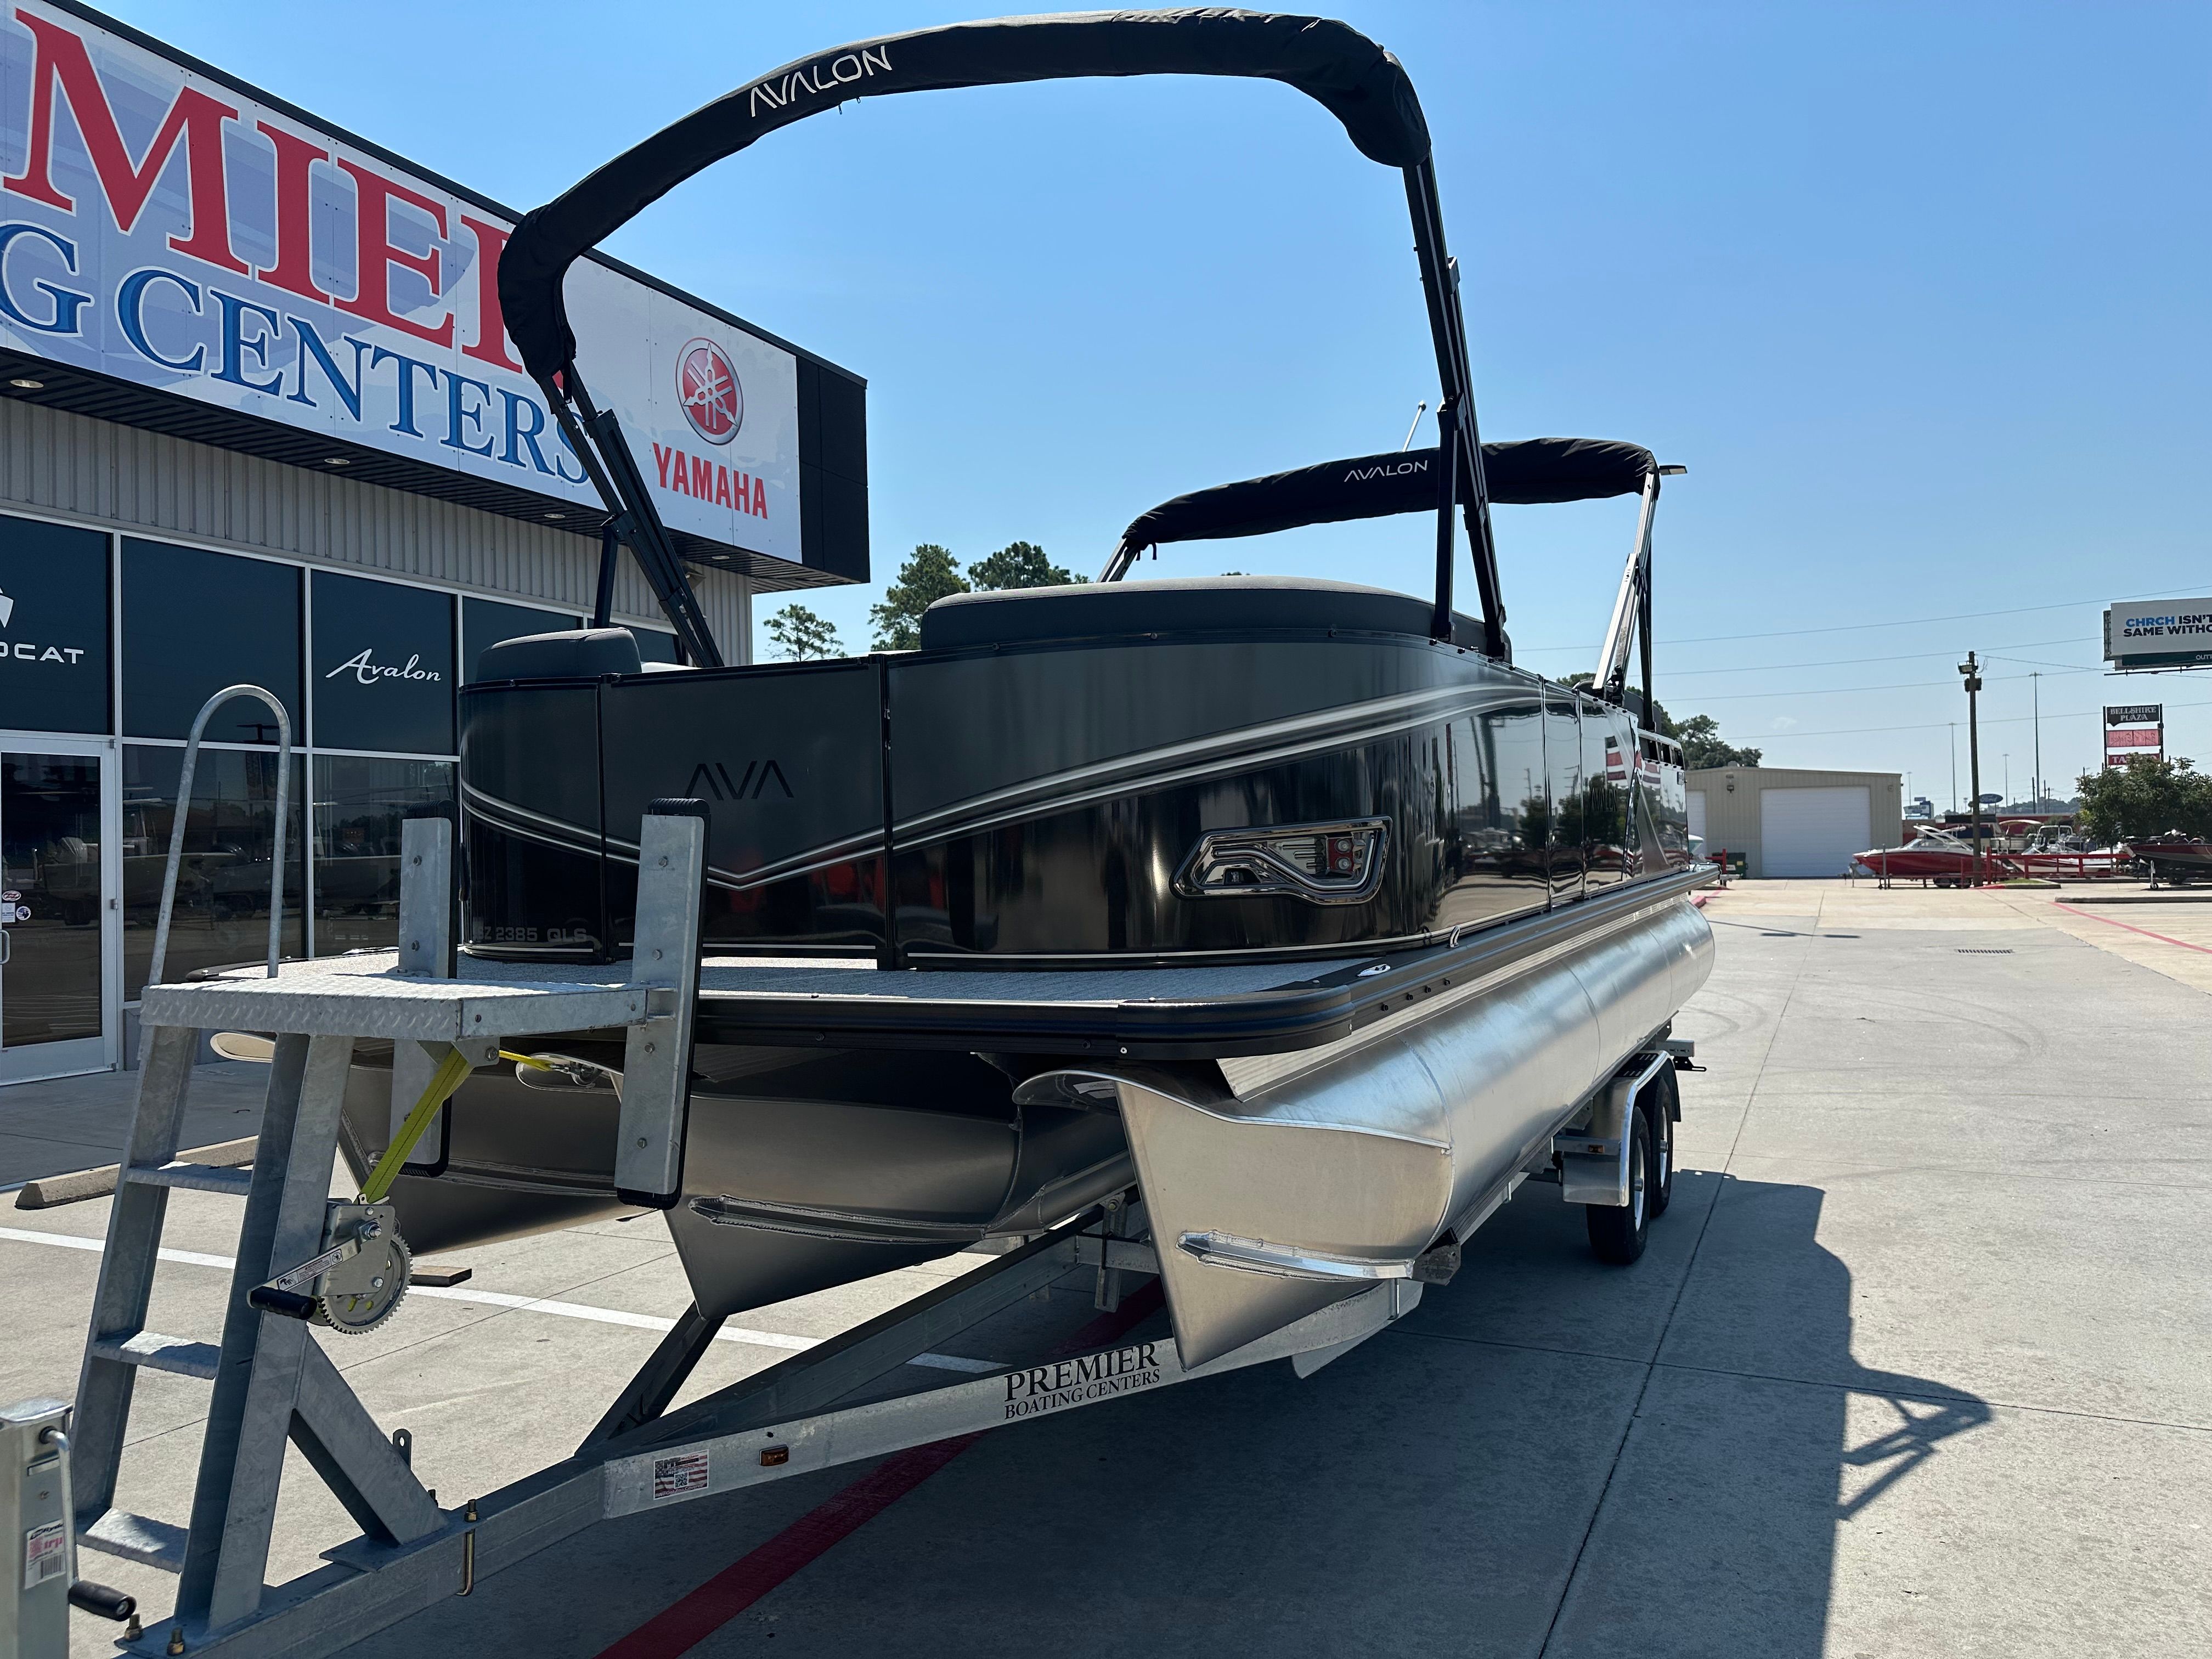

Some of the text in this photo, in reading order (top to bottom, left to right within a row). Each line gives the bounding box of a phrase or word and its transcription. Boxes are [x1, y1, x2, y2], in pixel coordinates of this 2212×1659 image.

[751, 46, 892, 117] AVALON
[117, 269, 590, 484] CENTERS
[652, 442, 768, 520] YAMAHA
[1344, 460, 1427, 482] AVALON
[2123, 626, 2164, 637] SAME
[2126, 616, 2175, 627] CHRCH
[325, 648, 441, 684] Avalon
[2110, 706, 2157, 714] BELLSHIRE
[684, 760, 794, 800] AVA
[496, 927, 538, 941] 2385
[547, 928, 587, 942] QLS
[1005, 1343, 1160, 1402] PREMIER
[1005, 1369, 1160, 1420] BOATING CENTERS
